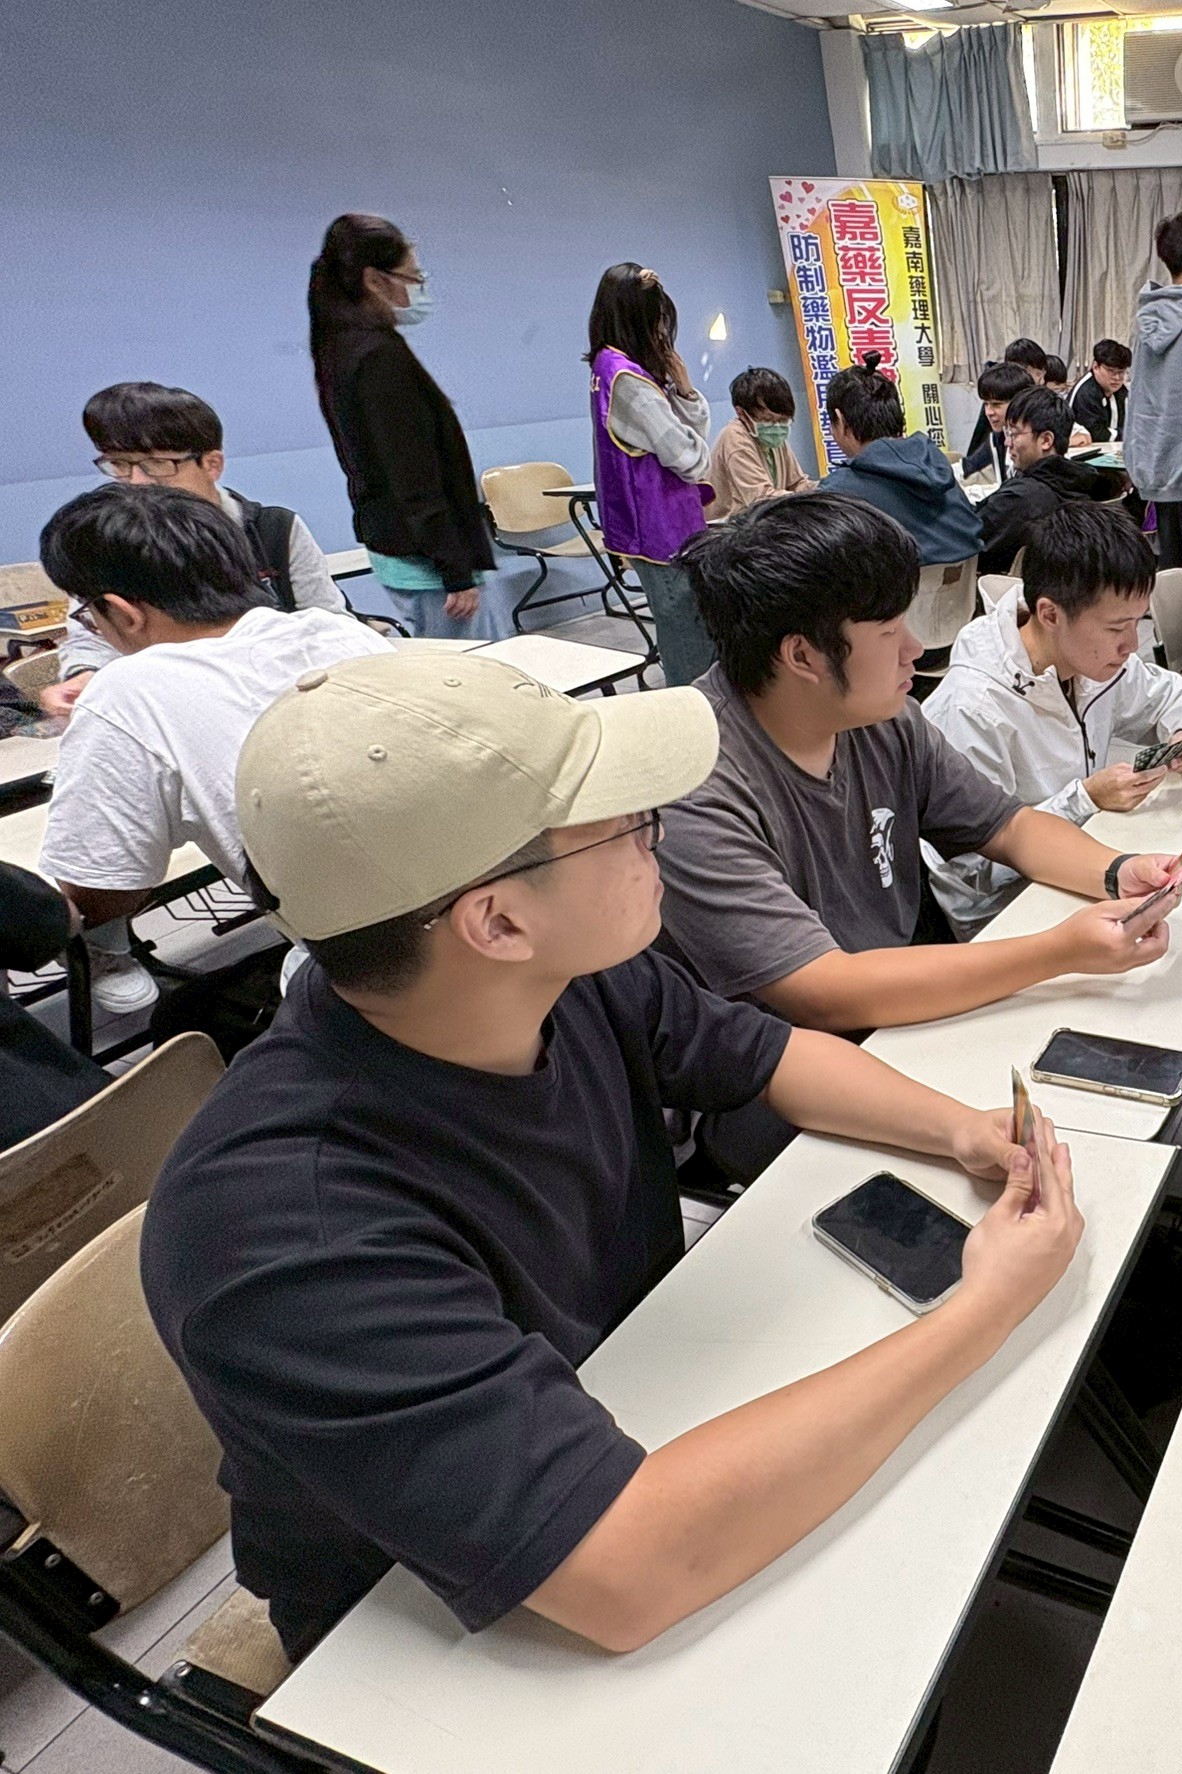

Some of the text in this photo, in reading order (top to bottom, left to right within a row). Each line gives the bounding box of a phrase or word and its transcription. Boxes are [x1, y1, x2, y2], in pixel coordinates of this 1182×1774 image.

[902, 226, 945, 448] 嘉南藥理大學 關心您
